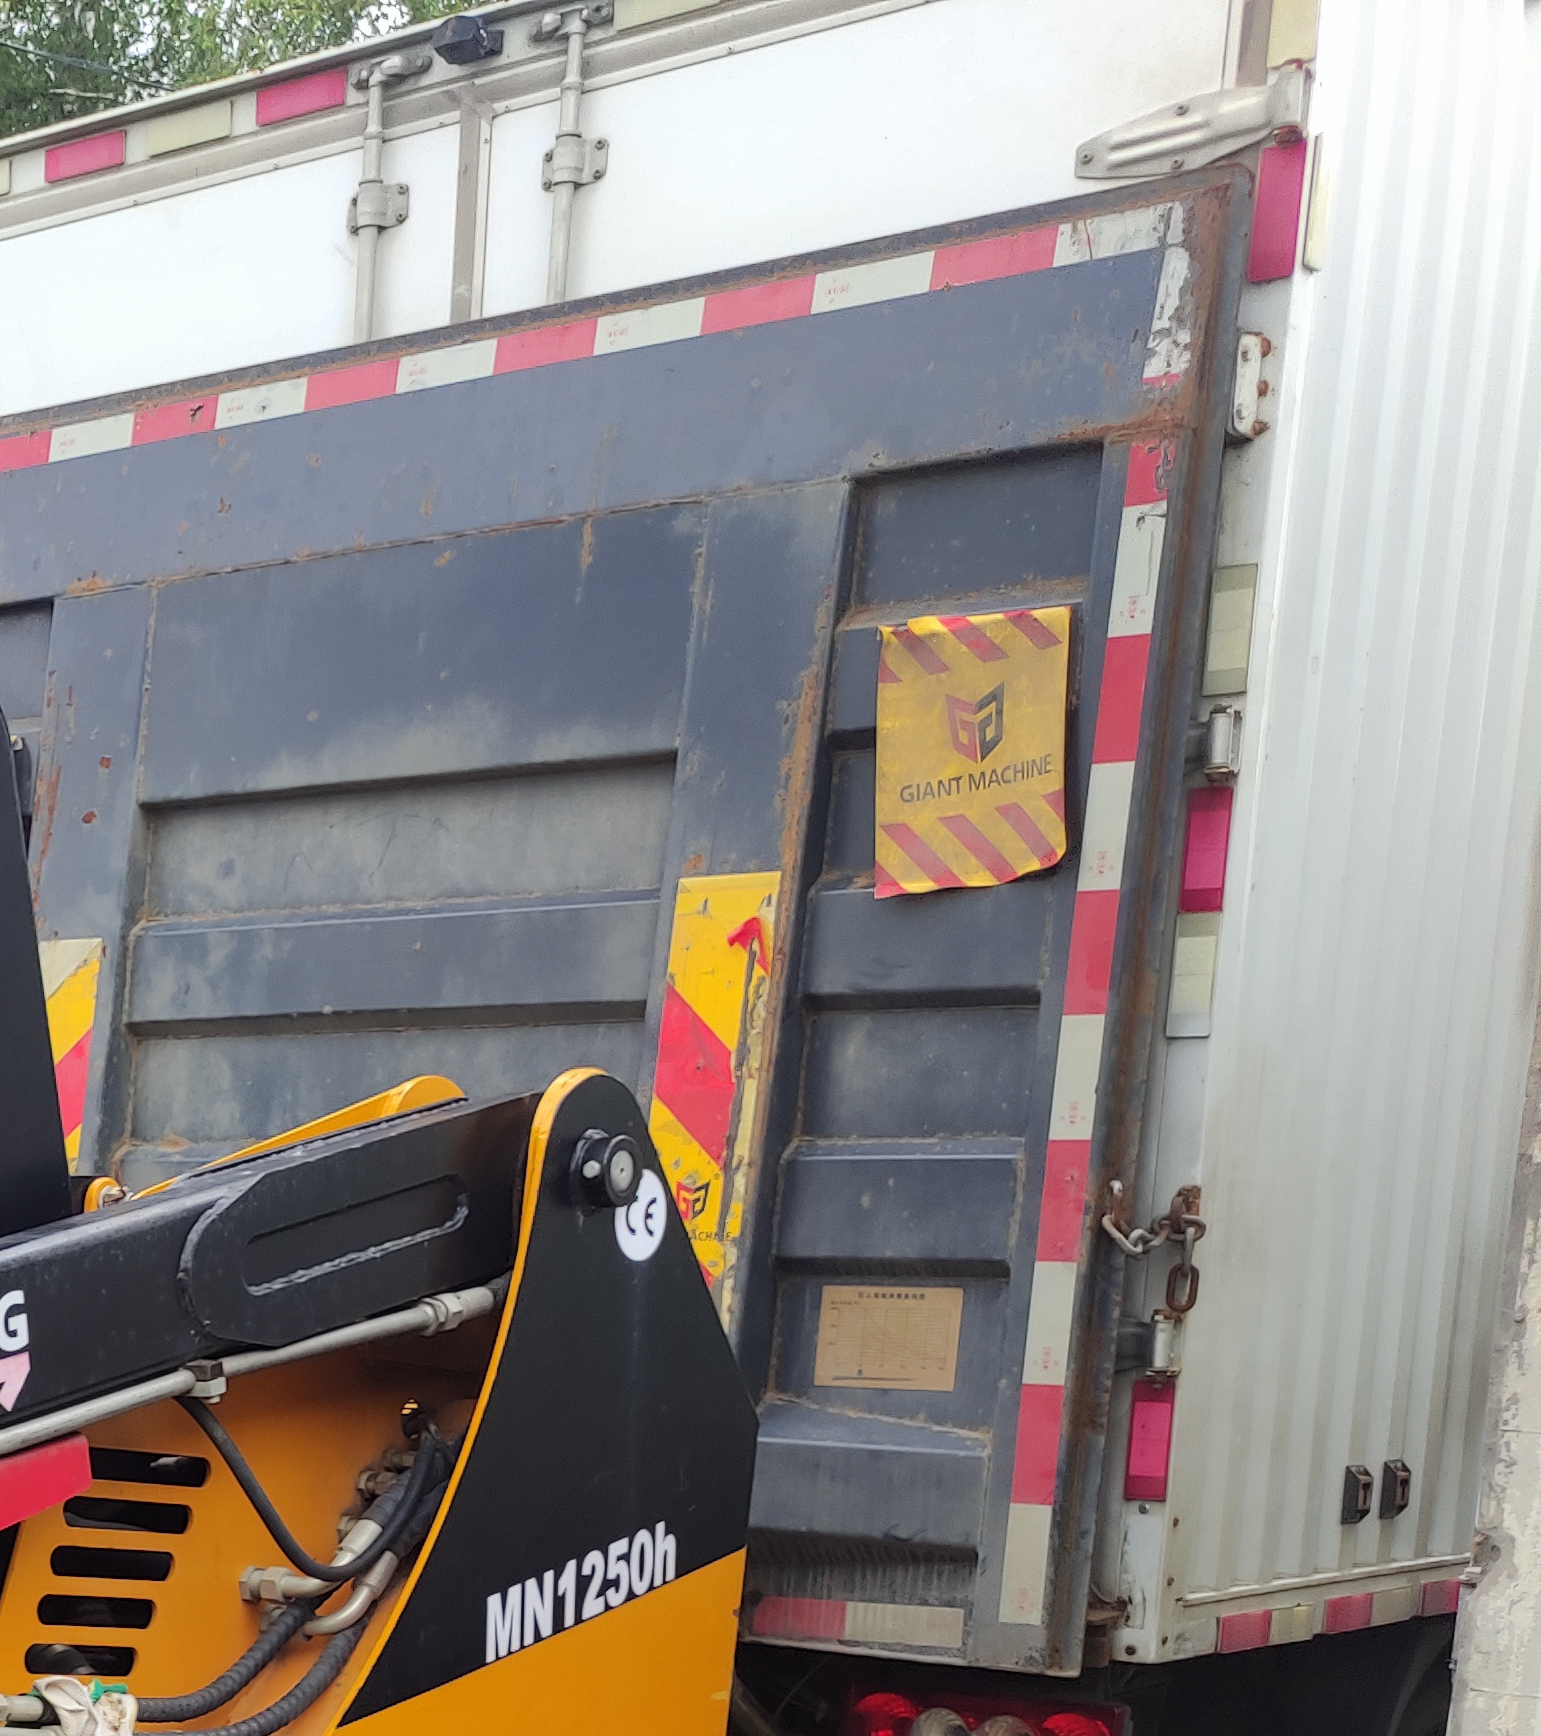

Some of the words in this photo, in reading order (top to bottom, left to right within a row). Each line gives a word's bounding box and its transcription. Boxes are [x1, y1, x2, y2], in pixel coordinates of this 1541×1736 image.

[899, 775, 964, 803] GIANT
[967, 753, 1053, 792] MACHINE
[485, 1520, 677, 1664] MN1250h
